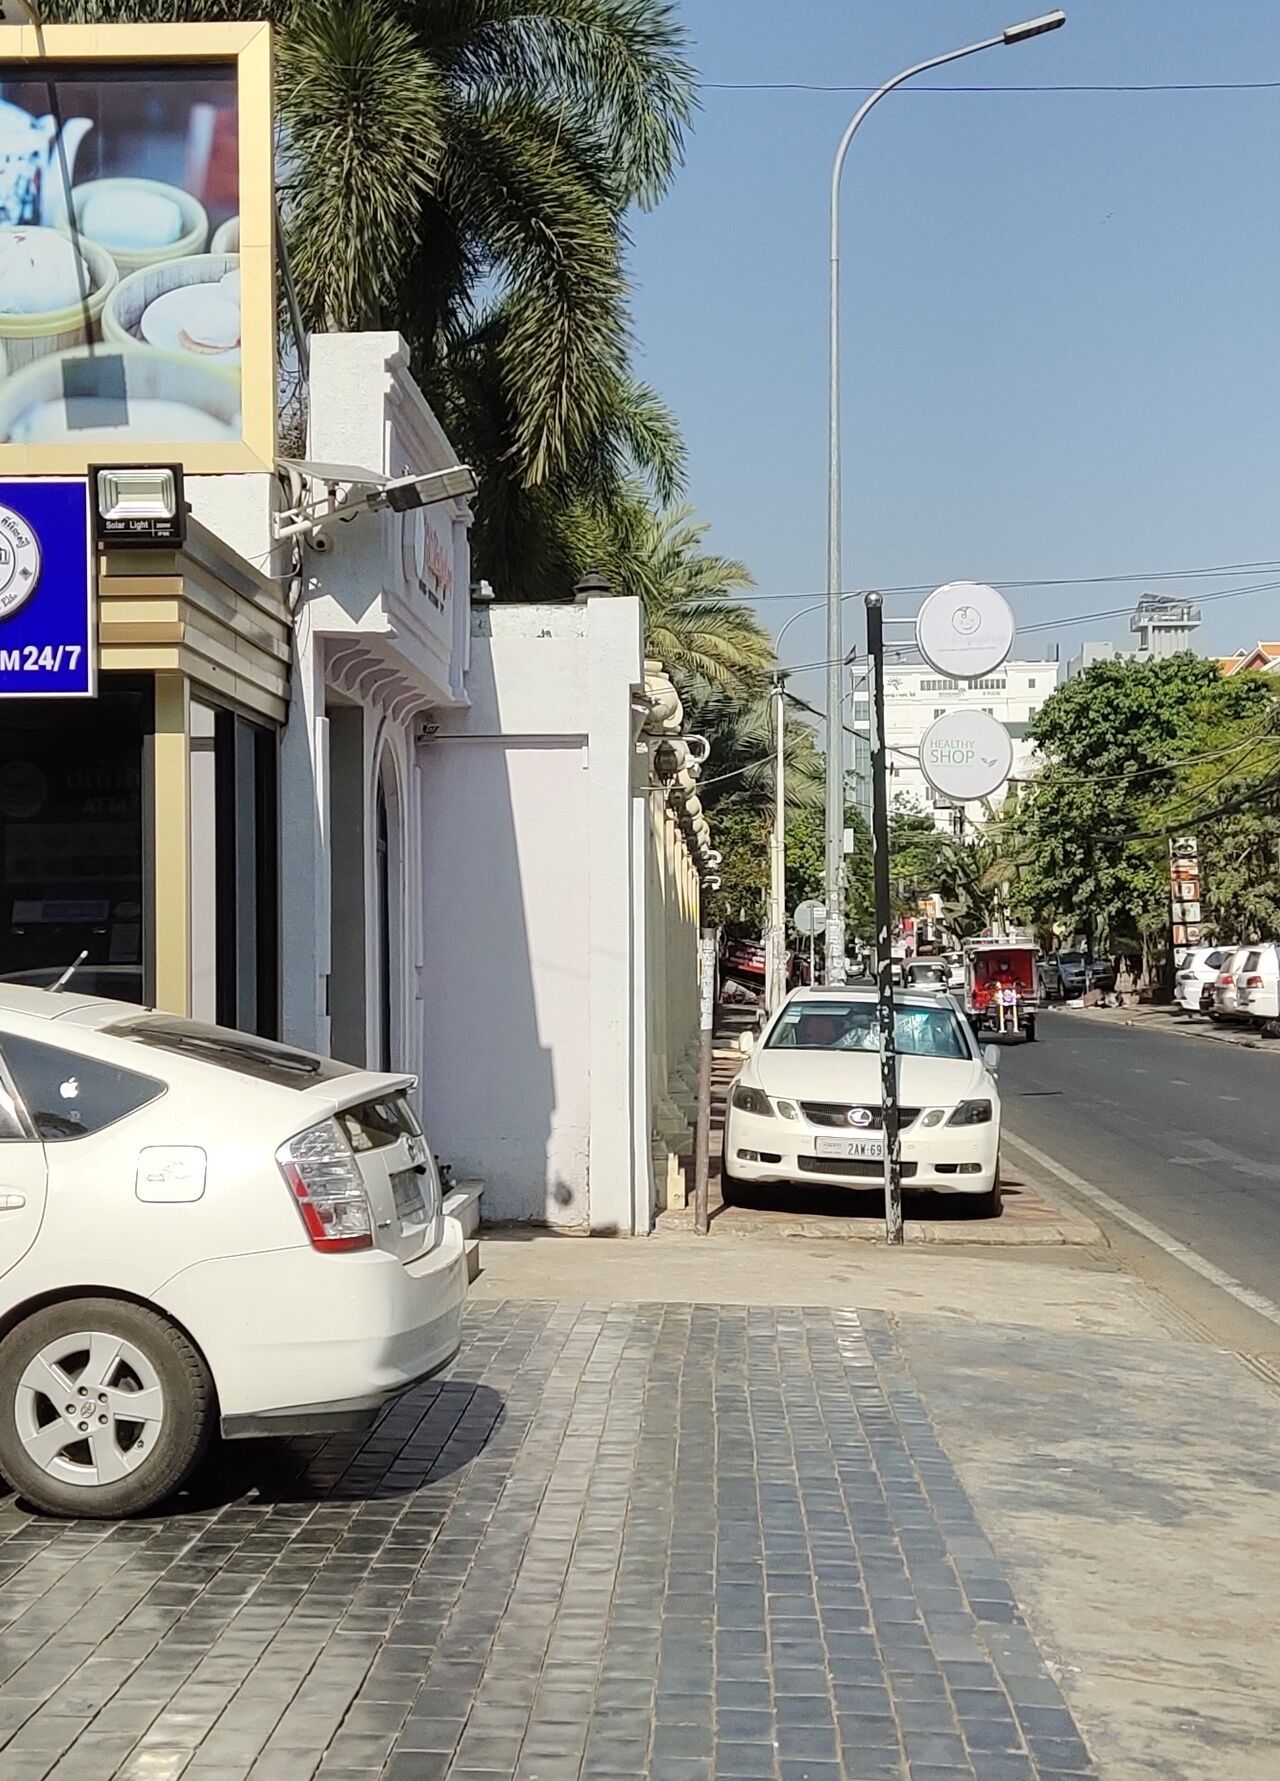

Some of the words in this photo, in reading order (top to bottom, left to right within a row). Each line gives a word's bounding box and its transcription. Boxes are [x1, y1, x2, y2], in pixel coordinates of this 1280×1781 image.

[129, 521, 148, 531] Light
[23, 645, 82, 672] 24/7
[930, 740, 975, 748] HEALTHY
[930, 749, 975, 764] SHOP
[848, 1143, 882, 1156] 2AW-69
